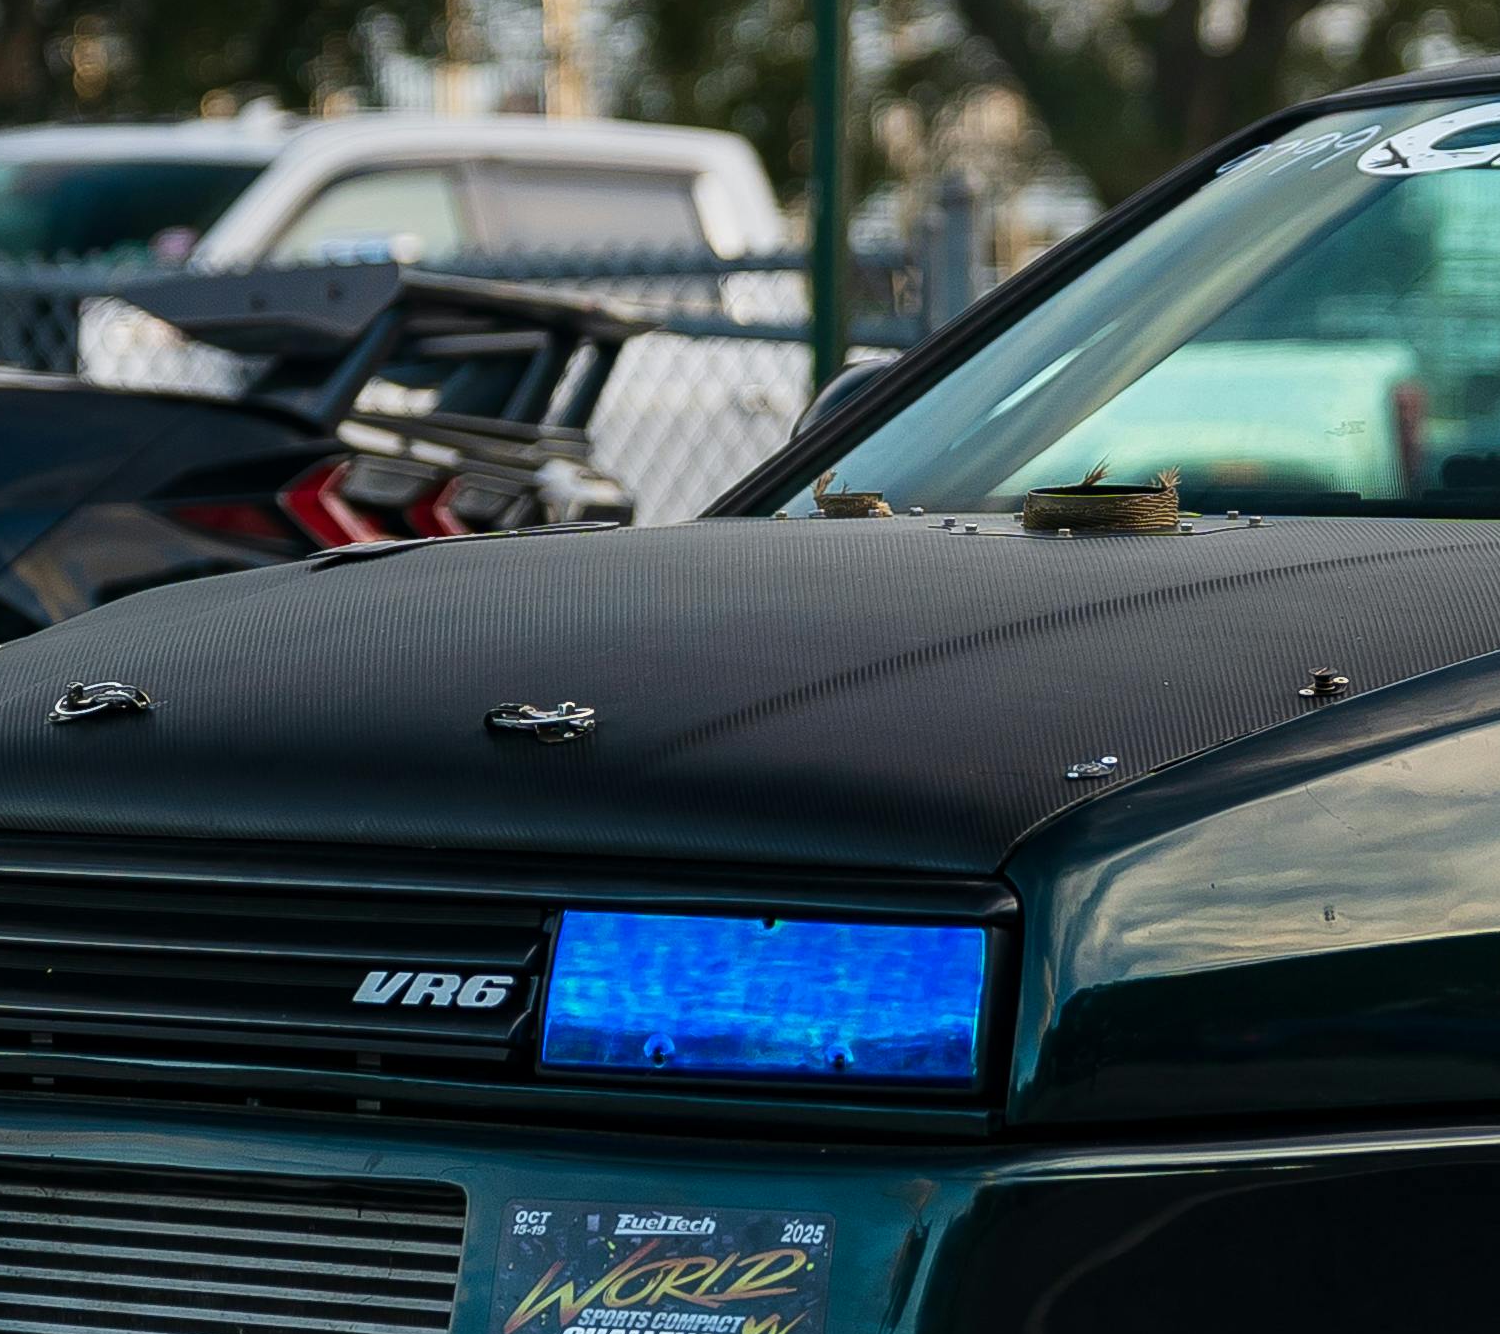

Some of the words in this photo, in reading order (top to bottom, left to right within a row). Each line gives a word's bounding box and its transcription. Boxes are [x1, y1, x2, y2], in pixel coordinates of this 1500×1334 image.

[352, 971, 514, 1007] VR6
[515, 1211, 552, 1225] OCT
[614, 1213, 716, 1236] FuelTech
[512, 1224, 547, 1236] 15-19
[780, 1223, 826, 1245] 2025
[577, 1308, 651, 1330] SPORTS
[650, 1312, 745, 1334] COMPACT
